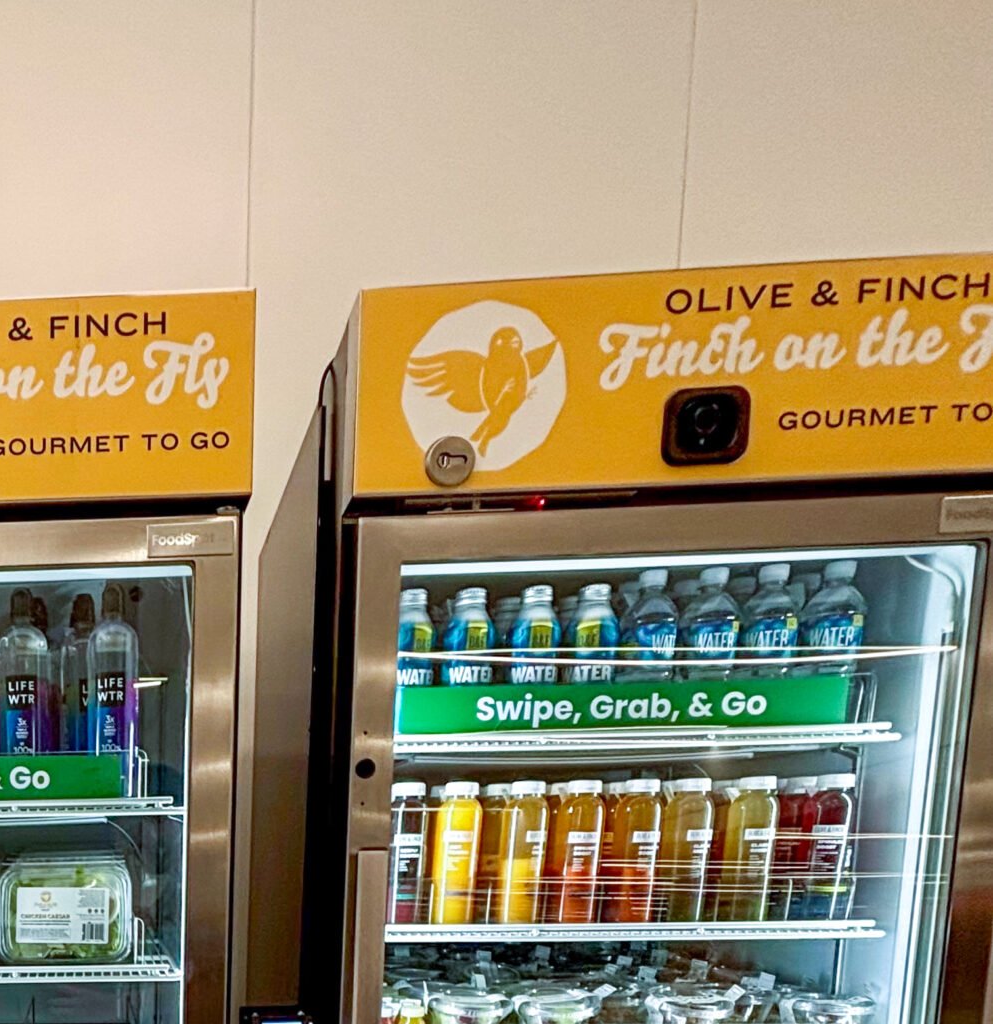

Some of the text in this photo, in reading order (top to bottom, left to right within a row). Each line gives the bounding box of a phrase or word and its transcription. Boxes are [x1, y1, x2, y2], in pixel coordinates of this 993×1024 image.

[667, 272, 991, 315] OLIVE & FINCH
[7, 317, 33, 341] &
[49, 311, 168, 339] FINCH
[598, 313, 763, 391] Finch
[773, 332, 848, 372] on
[856, 307, 950, 368] the
[53, 345, 136, 397] the
[143, 332, 230, 409] Fly
[778, 402, 993, 431] GOURMET TO
[141, 433, 182, 453] TO
[191, 430, 231, 451] GO
[8, 681, 35, 691] LIFE
[97, 678, 124, 688] LIFE
[8, 694, 35, 704] WTR
[97, 691, 124, 702] WTR
[476, 691, 767, 727] Swipe, Grab, & Go
[9, 766, 51, 790] Go
